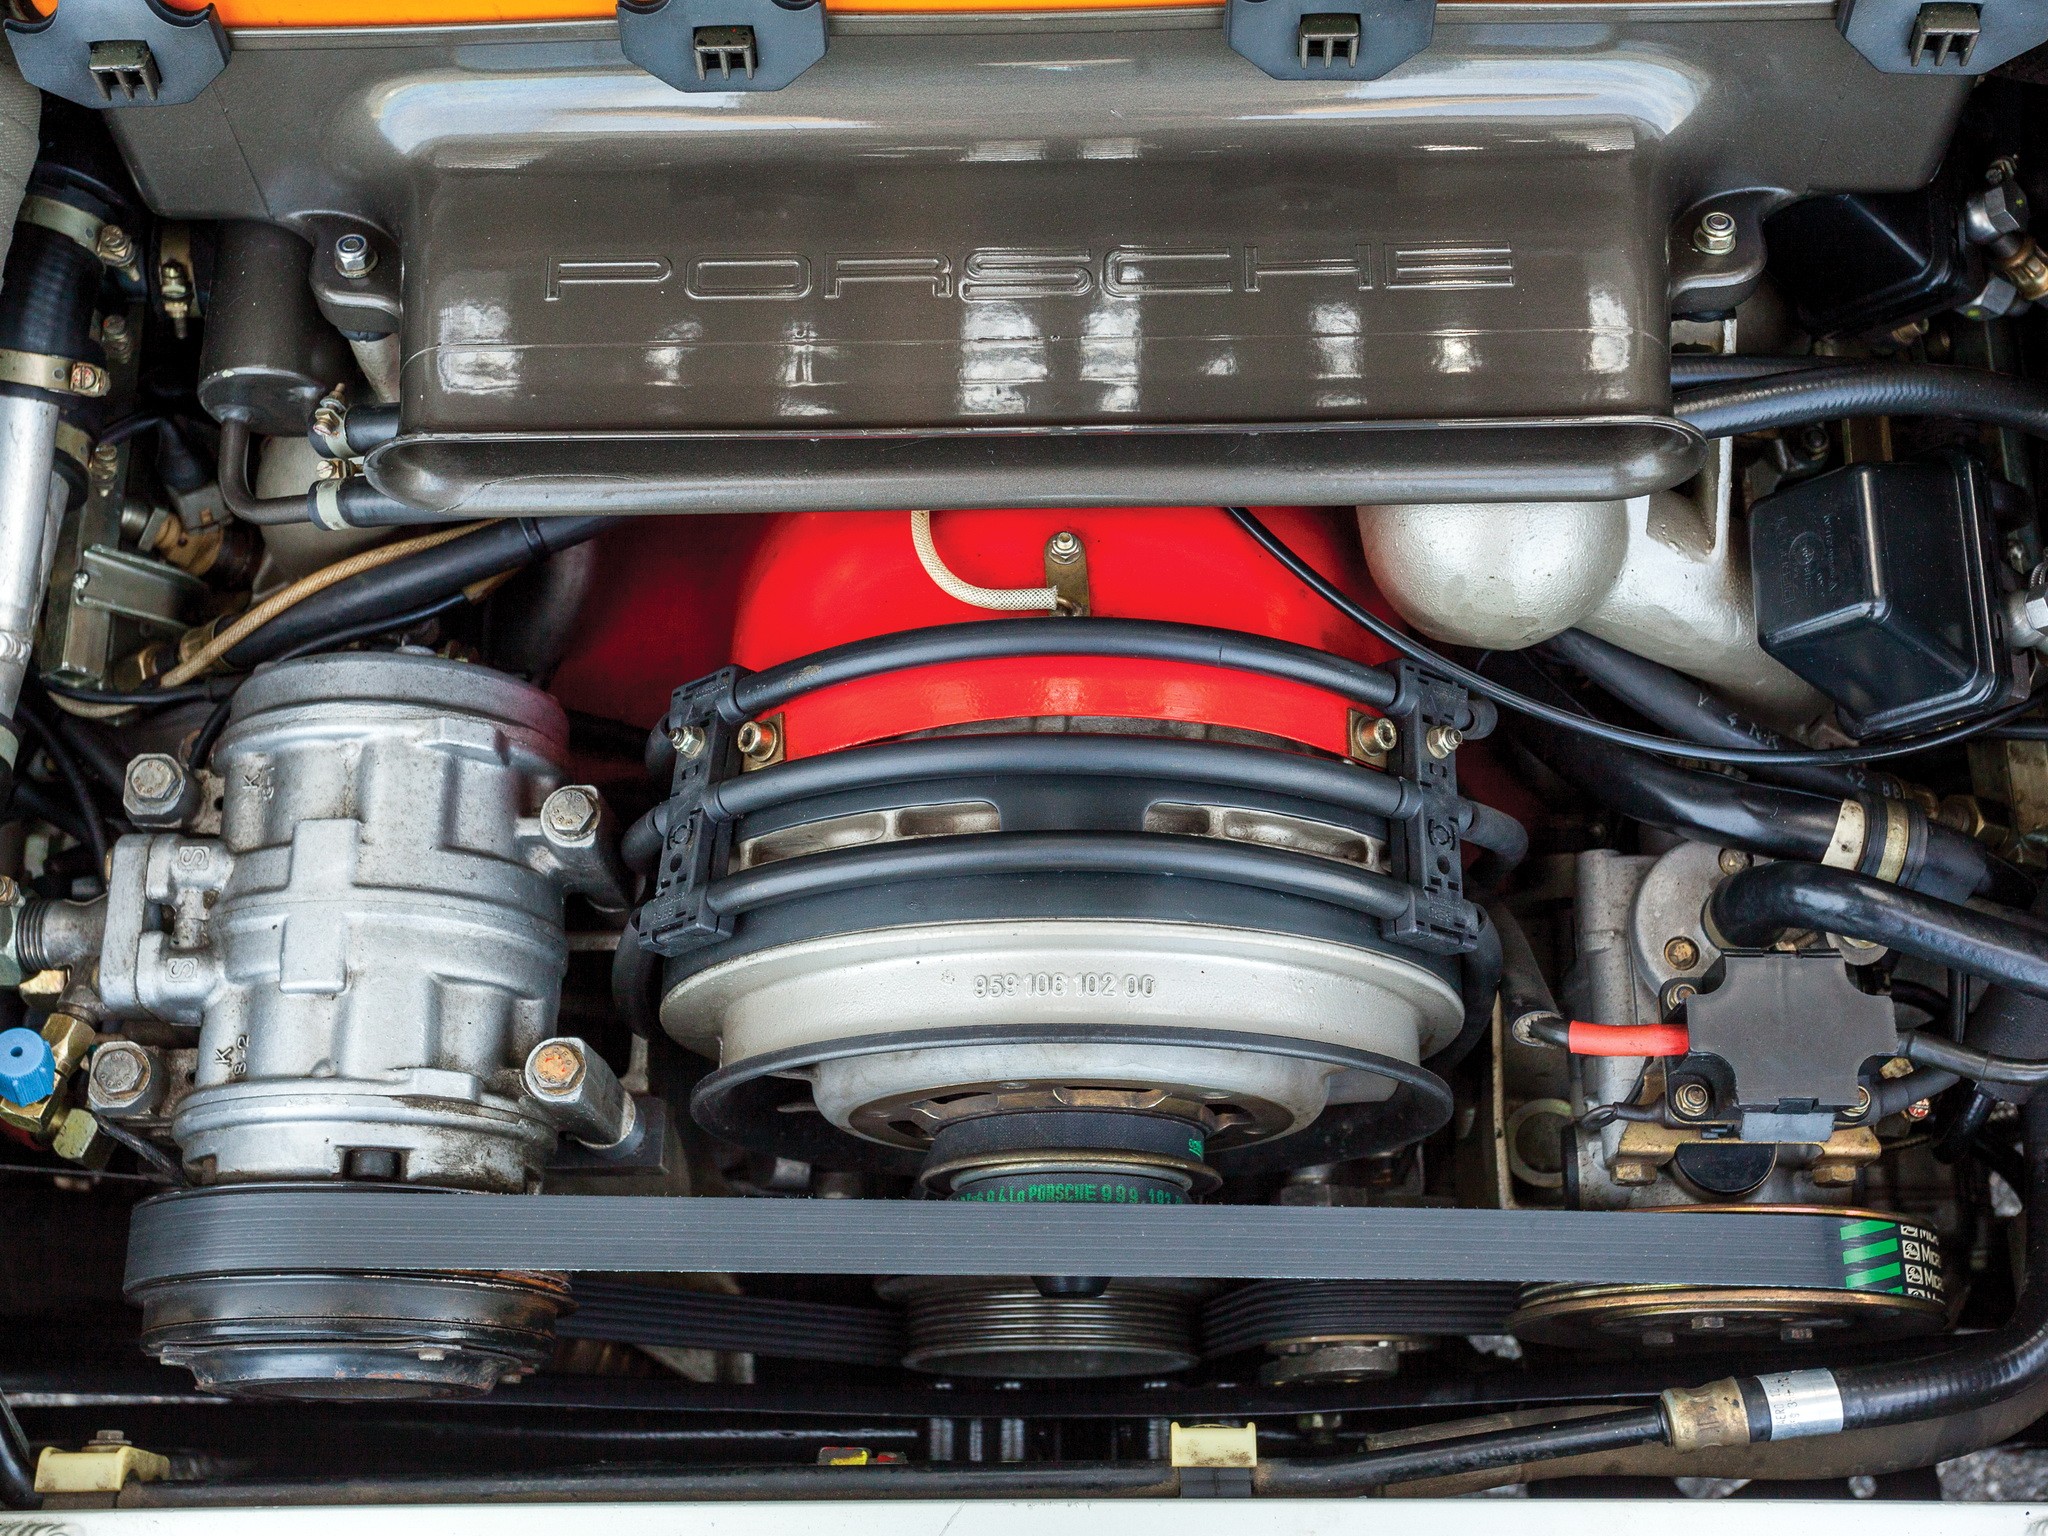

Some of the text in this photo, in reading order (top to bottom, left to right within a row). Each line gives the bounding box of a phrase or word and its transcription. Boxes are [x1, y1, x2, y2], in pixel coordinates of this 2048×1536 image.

[544, 240, 1514, 301] PORSCHE
[181, 849, 205, 866] S
[169, 960, 194, 979] S
[973, 972, 1155, 998] 959 106 102 00
[215, 1047, 233, 1064] K
[233, 1034, 250, 1075] 8-2
[1028, 1183, 1097, 1202] PORSCHE
